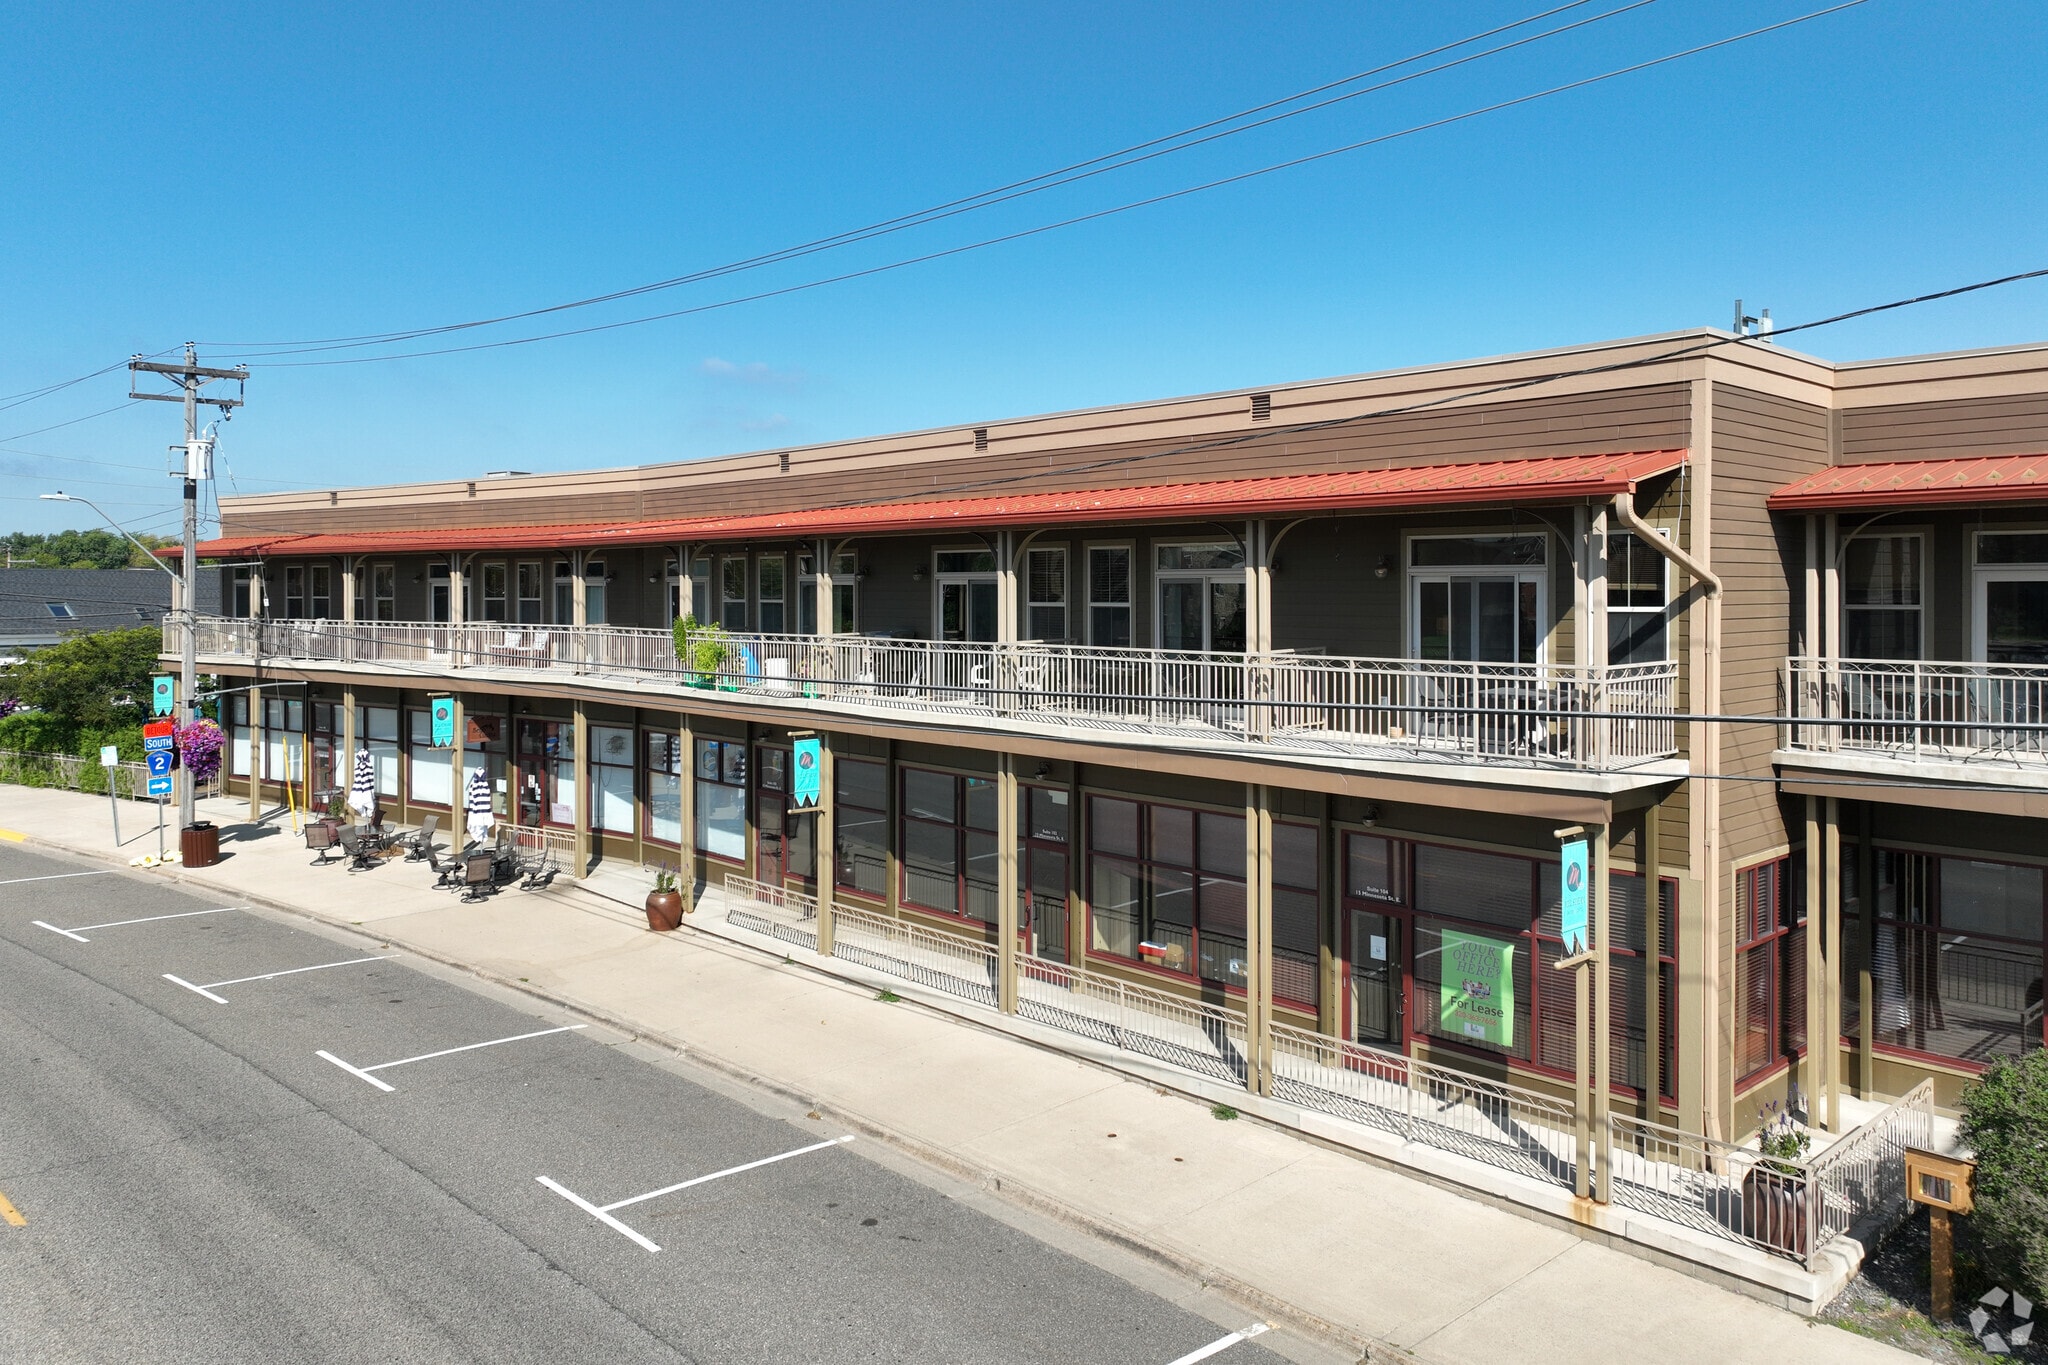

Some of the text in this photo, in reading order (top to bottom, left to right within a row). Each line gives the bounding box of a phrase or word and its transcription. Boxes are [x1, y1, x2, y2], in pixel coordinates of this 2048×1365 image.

[146, 726, 170, 736] DETOUR
[146, 738, 172, 749] SOUTH
[154, 757, 165, 770] 2
[1362, 890, 1387, 900] Minnesota
[1462, 942, 1496, 957] YOUR
[1452, 949, 1500, 969] OFFICE
[1456, 960, 1501, 979] HERE?
[1450, 996, 1504, 1018] For Lease
